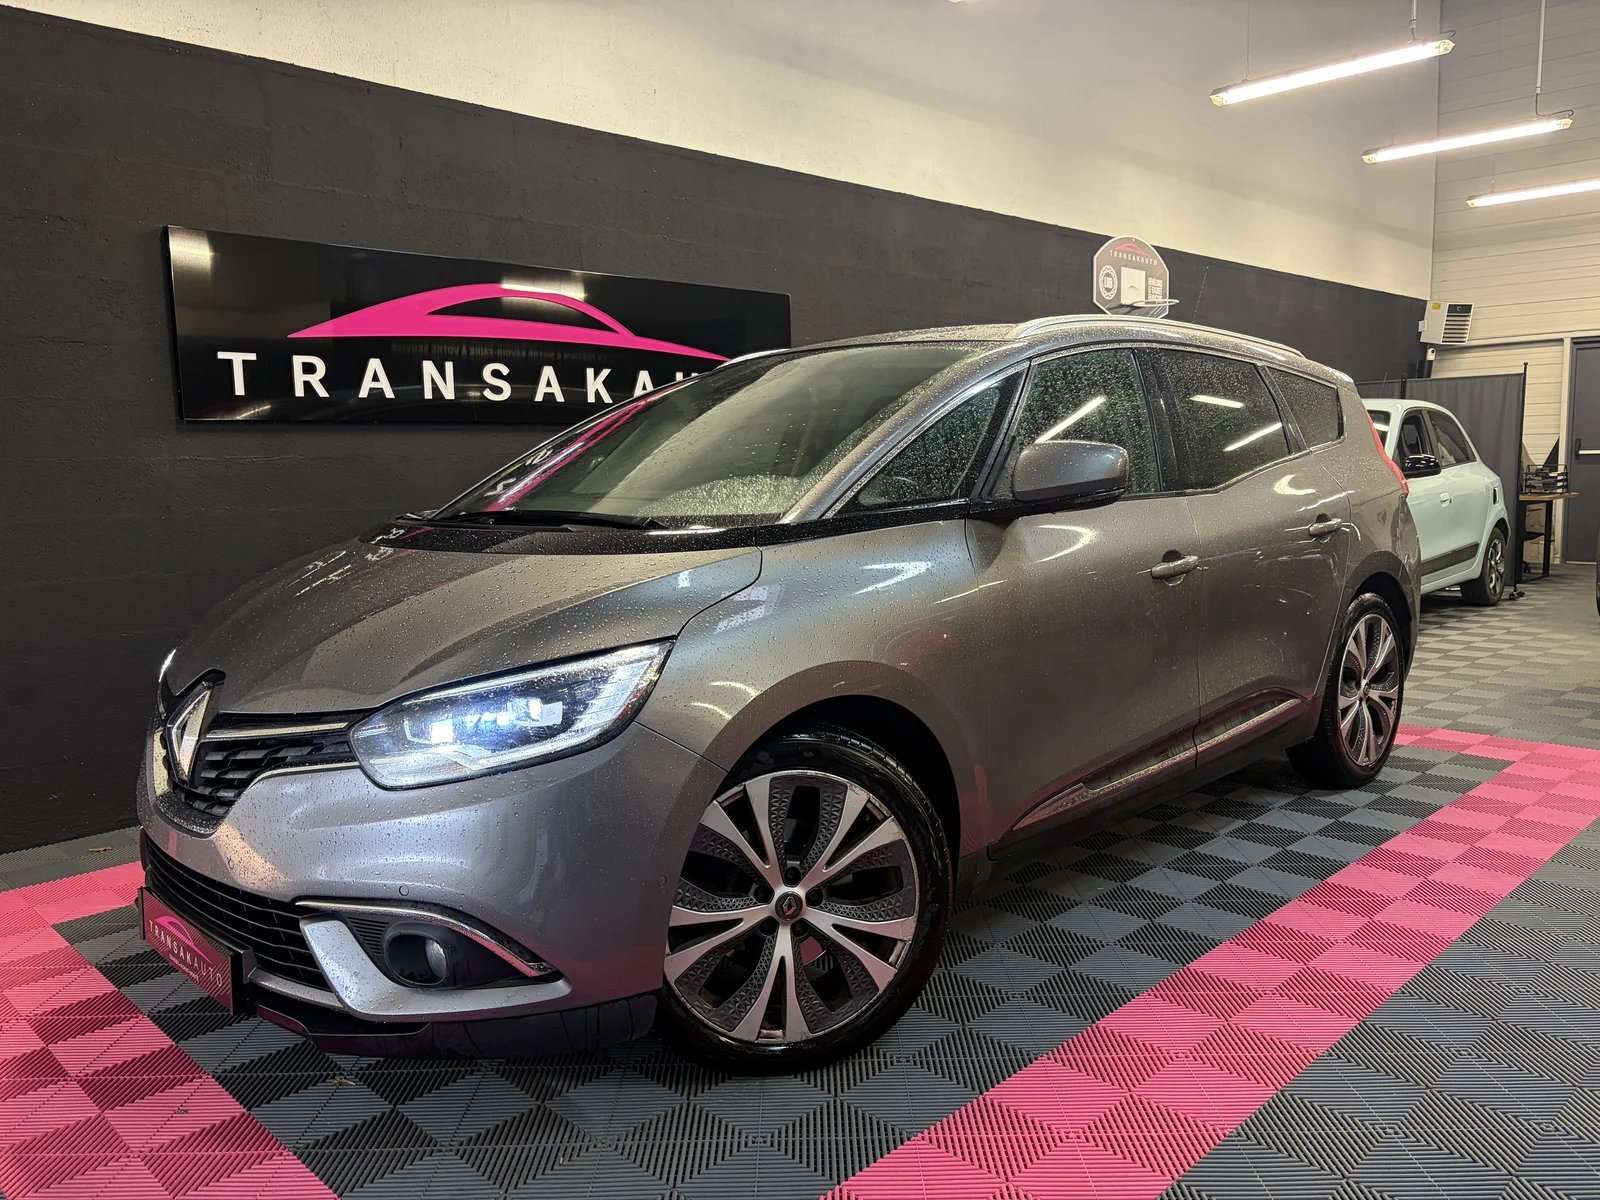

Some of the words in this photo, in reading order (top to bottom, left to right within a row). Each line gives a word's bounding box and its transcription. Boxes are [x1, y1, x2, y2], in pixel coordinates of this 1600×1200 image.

[1109, 249, 1158, 266] TRANSAKAUTO
[217, 351, 699, 404] TRANSAKA
[149, 919, 222, 987] TRANSAKAUTO
